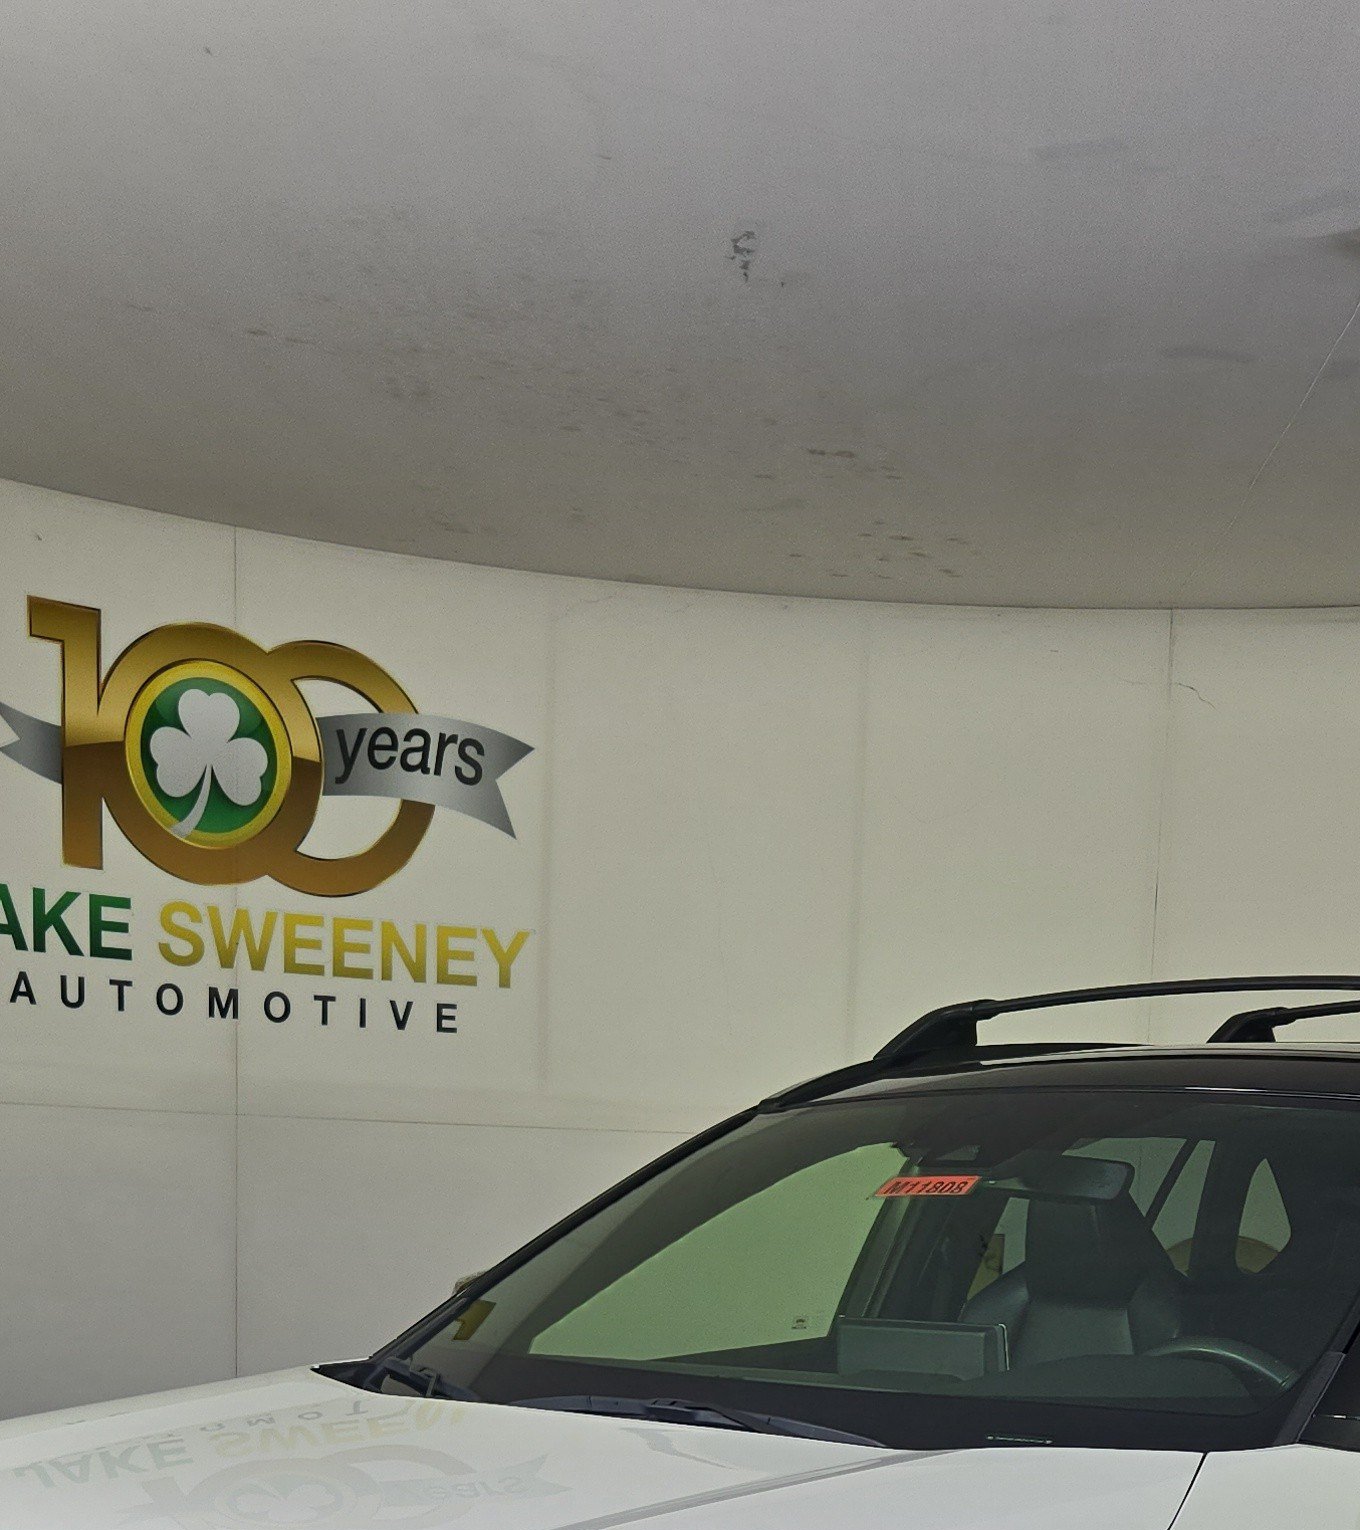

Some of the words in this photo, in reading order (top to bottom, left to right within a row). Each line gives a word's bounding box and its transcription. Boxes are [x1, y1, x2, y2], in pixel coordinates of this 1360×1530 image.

[26, 594, 437, 898] 100
[334, 724, 486, 787] years
[157, 899, 531, 990] SWEENEY
[9, 970, 459, 1035] AUTOMOTIVE
